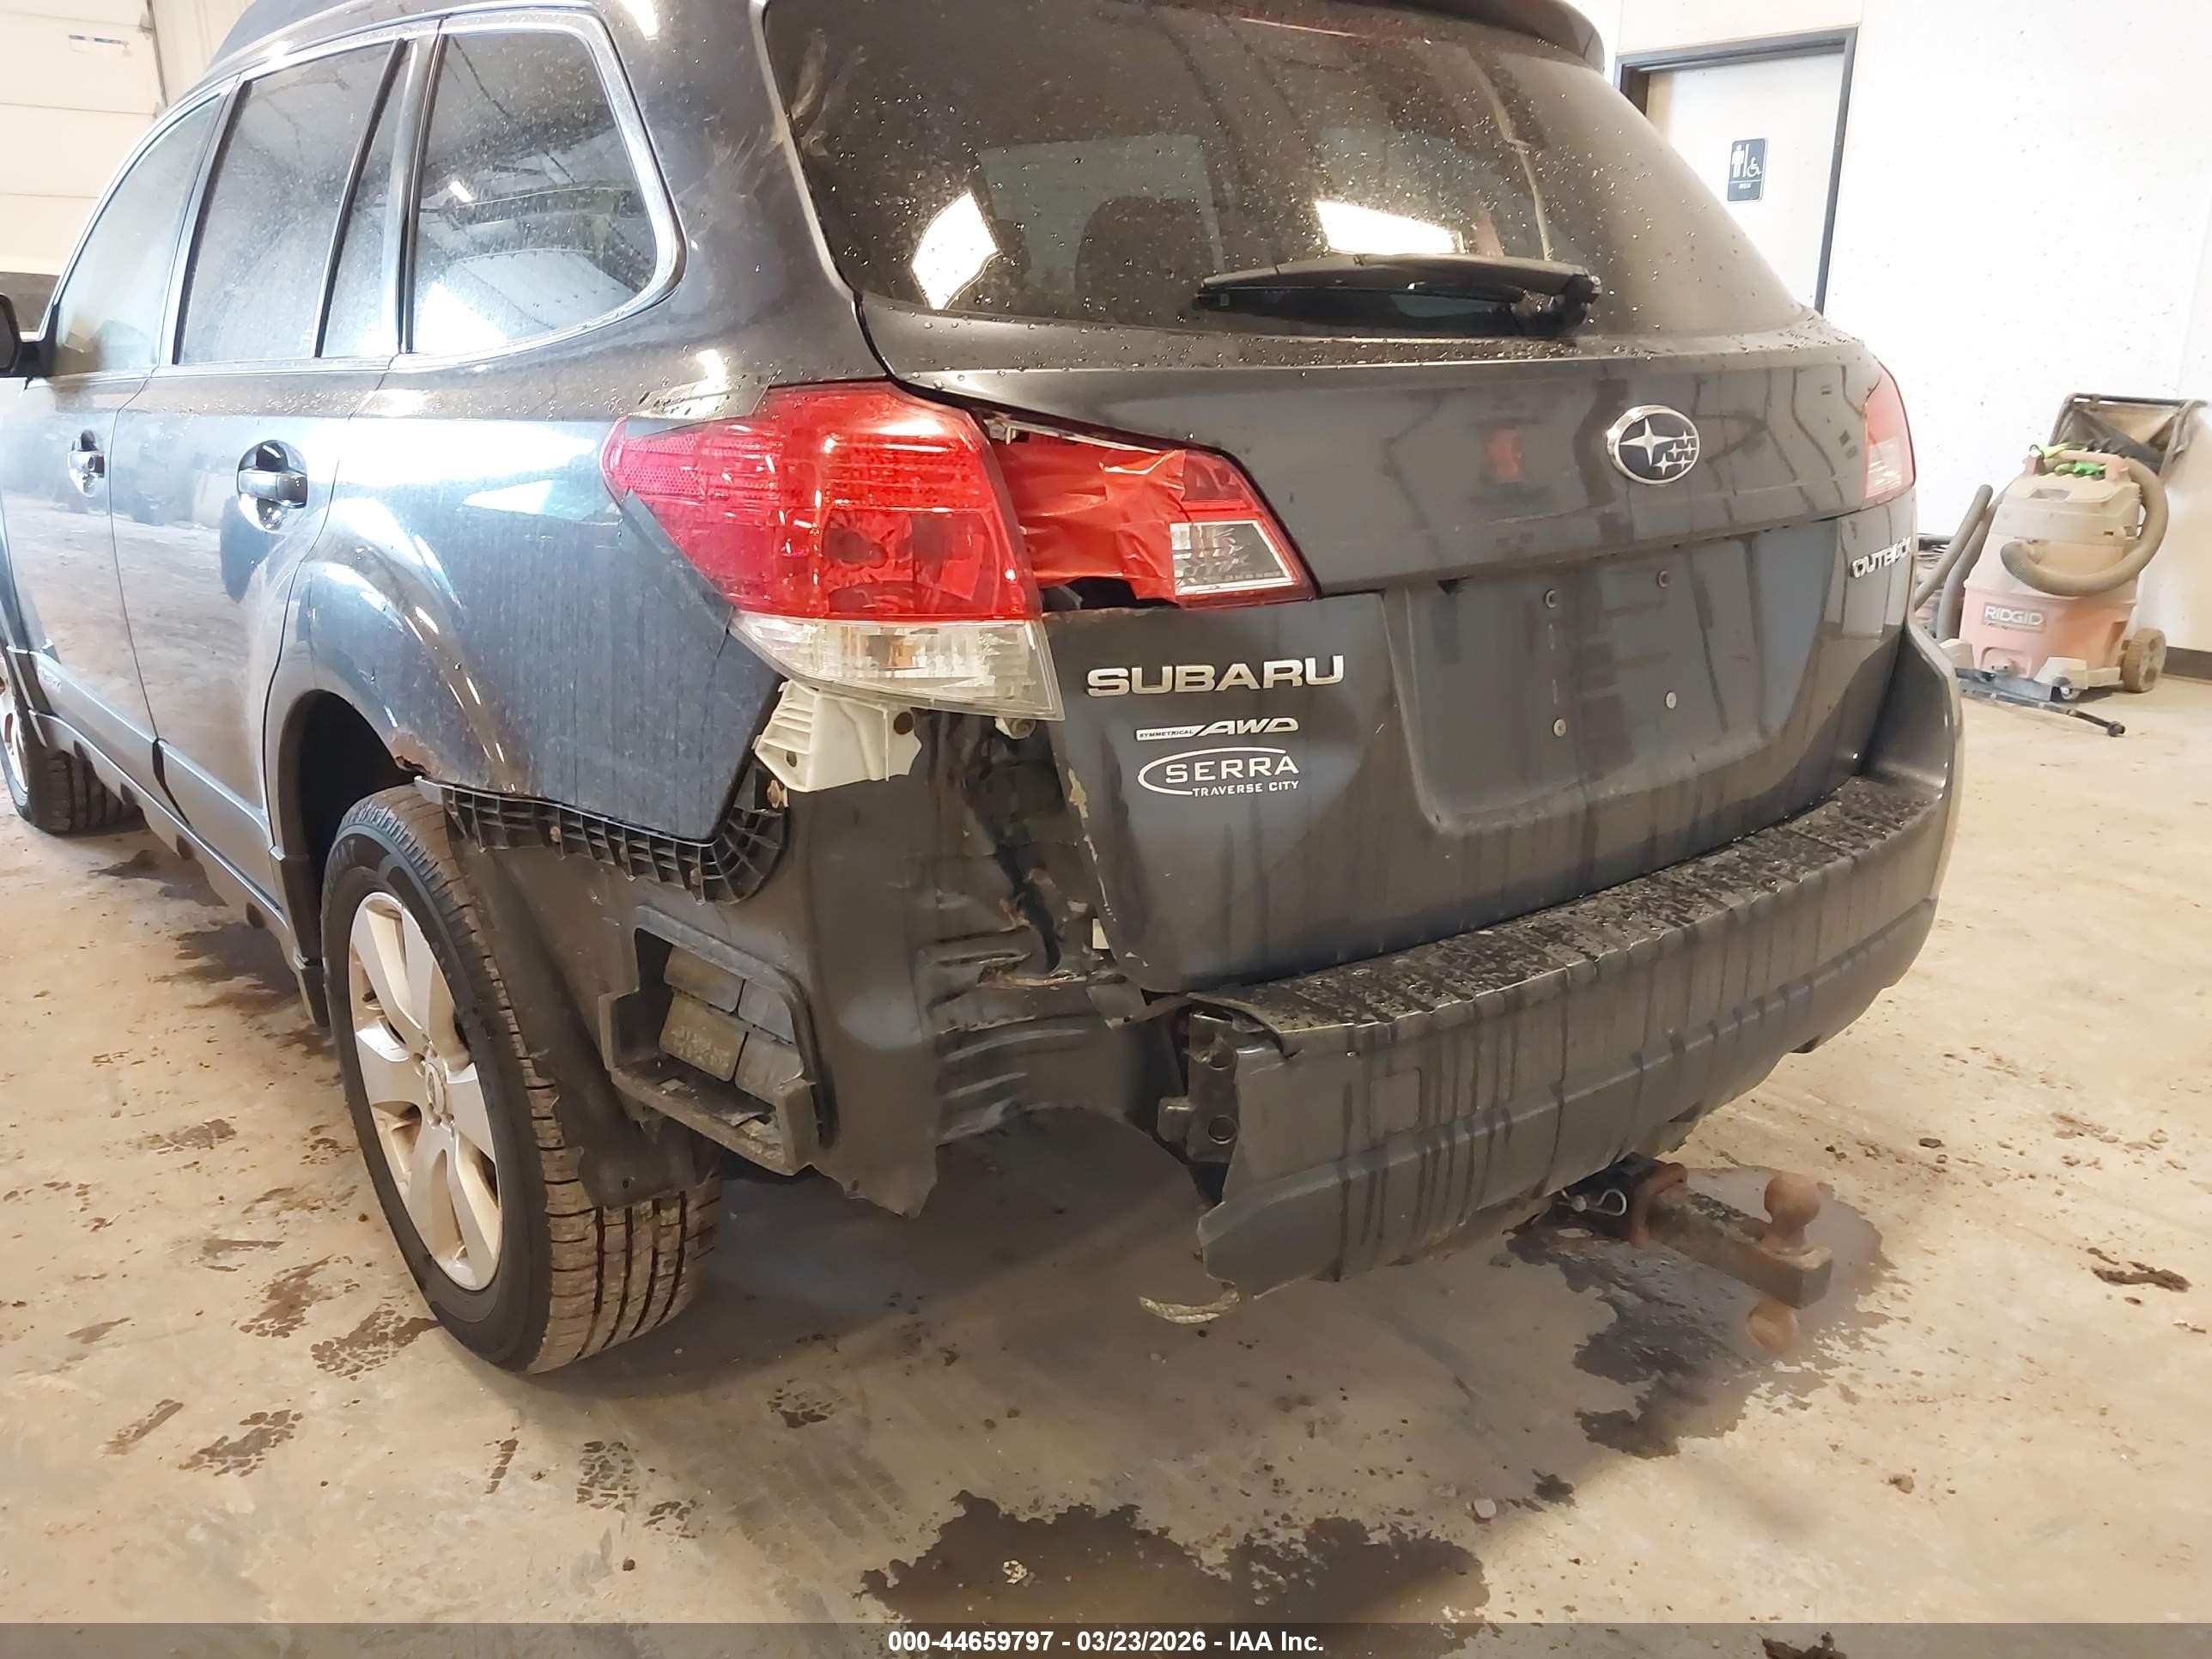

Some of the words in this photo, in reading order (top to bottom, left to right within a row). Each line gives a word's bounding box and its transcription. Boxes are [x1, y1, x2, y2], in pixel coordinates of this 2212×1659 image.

[1984, 605, 2045, 626] RIDGID
[1087, 654, 1345, 698] SUBARU
[1139, 729, 1194, 738] SYMMETRICAL
[1196, 717, 1299, 737] AWD
[1165, 755, 1299, 784] SERRA
[1192, 782, 1263, 798] TRAVERSE
[1268, 780, 1299, 791] CITY
